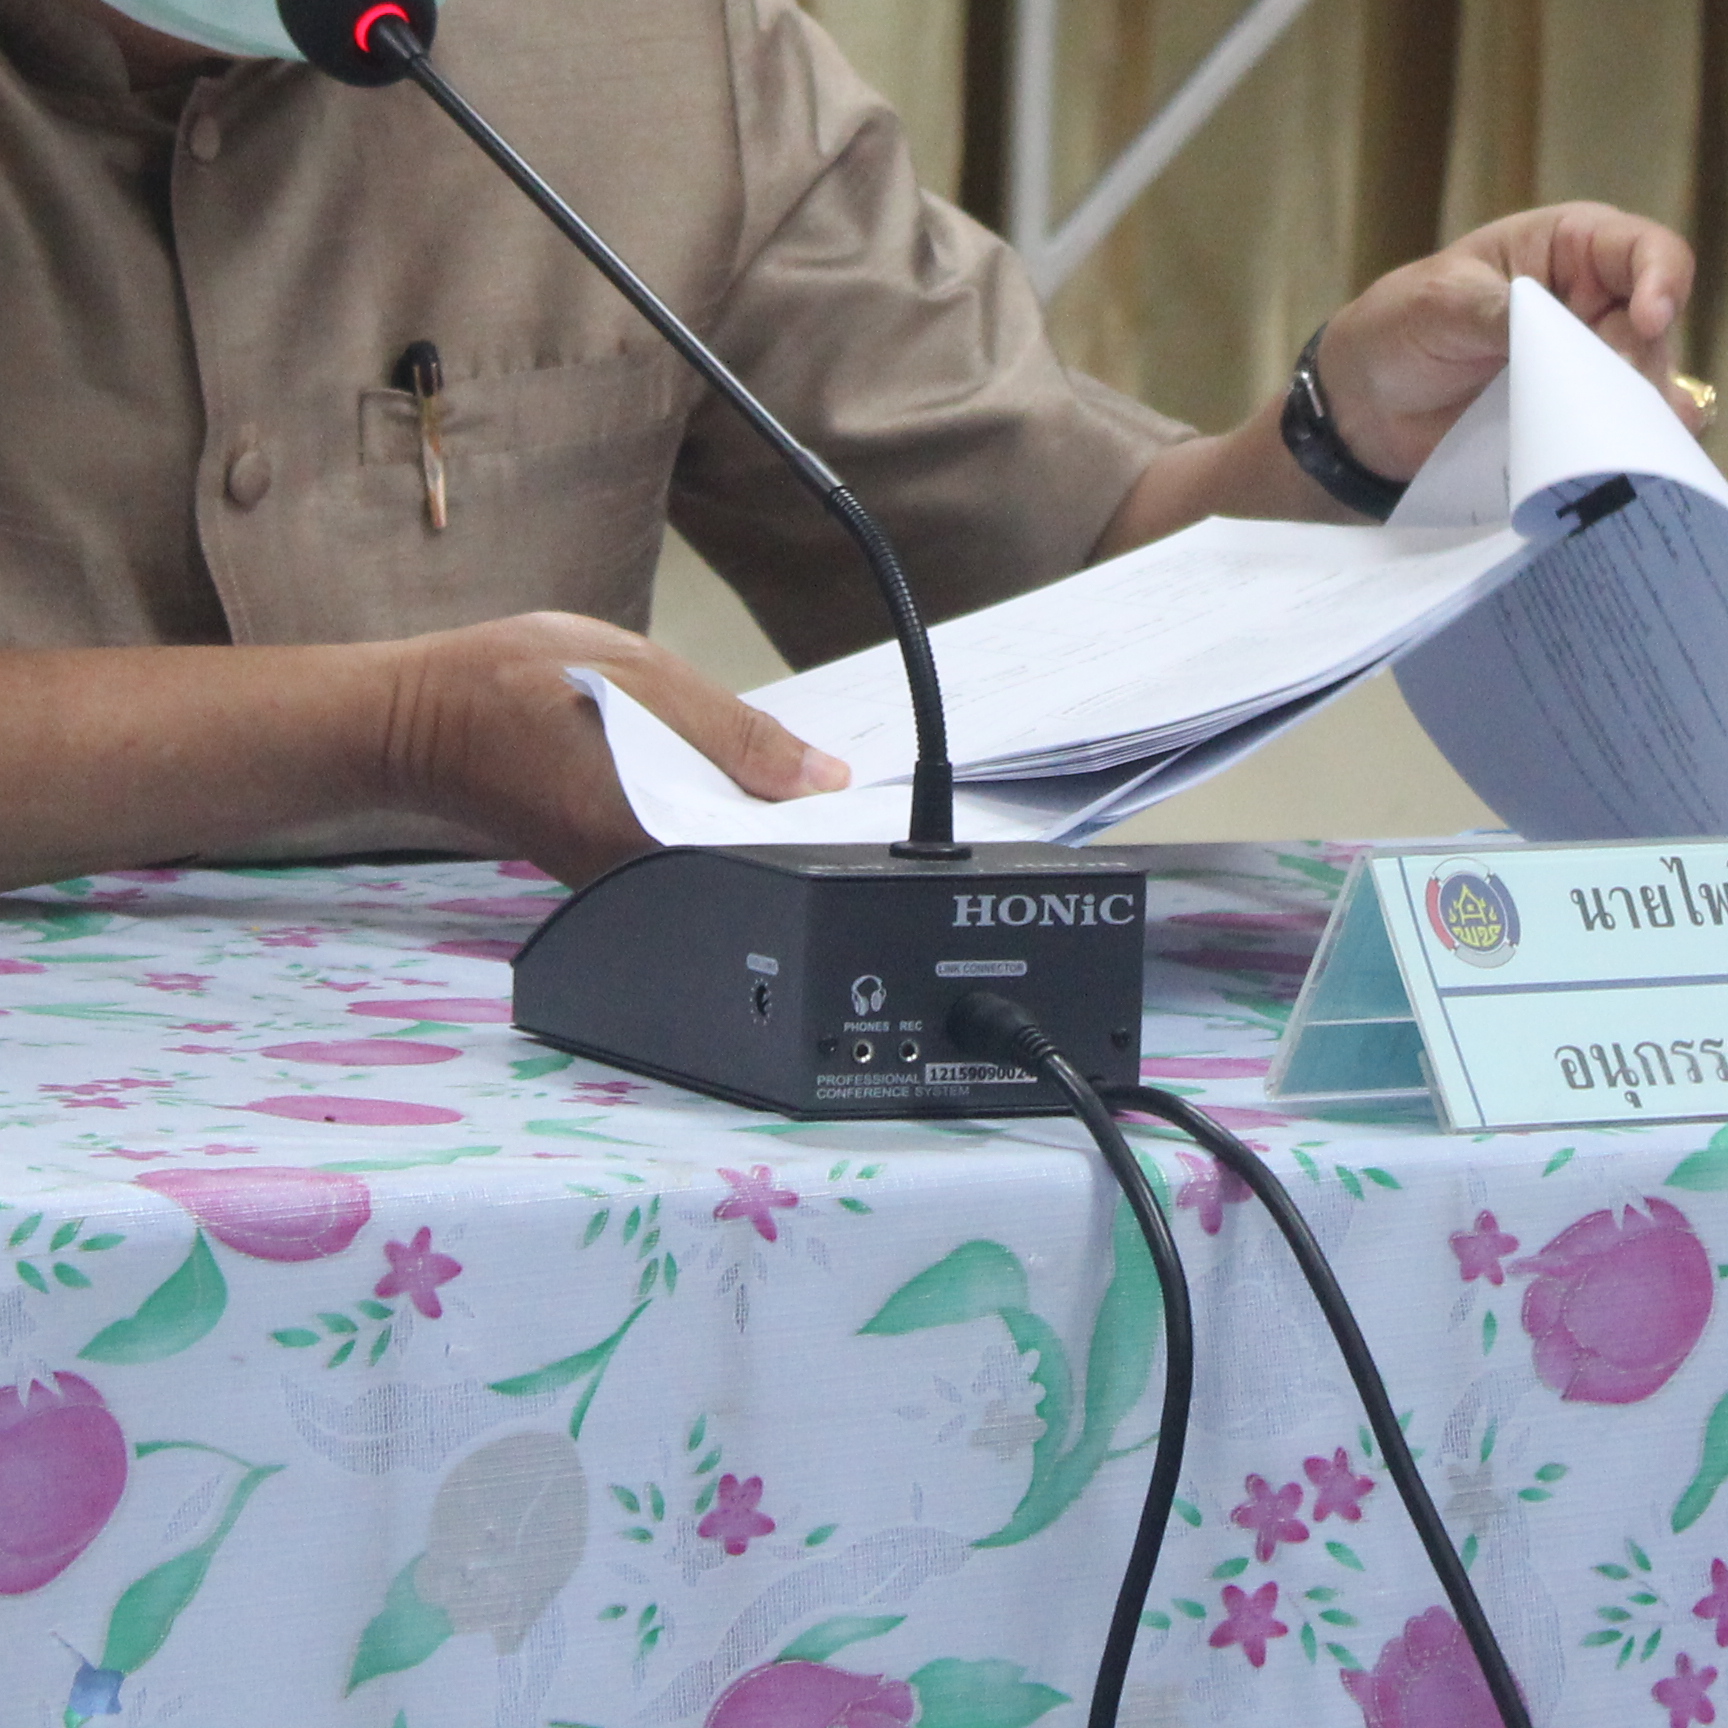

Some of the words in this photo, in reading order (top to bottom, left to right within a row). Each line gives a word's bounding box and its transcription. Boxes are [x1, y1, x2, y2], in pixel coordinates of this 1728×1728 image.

[843, 1021, 890, 1032] PHONES
[899, 1021, 923, 1032] REC
[816, 1073, 921, 1087] PROFESSIONAL
[816, 1086, 912, 1100] CONFERENCE
[914, 1085, 971, 1099] SYSTEM
